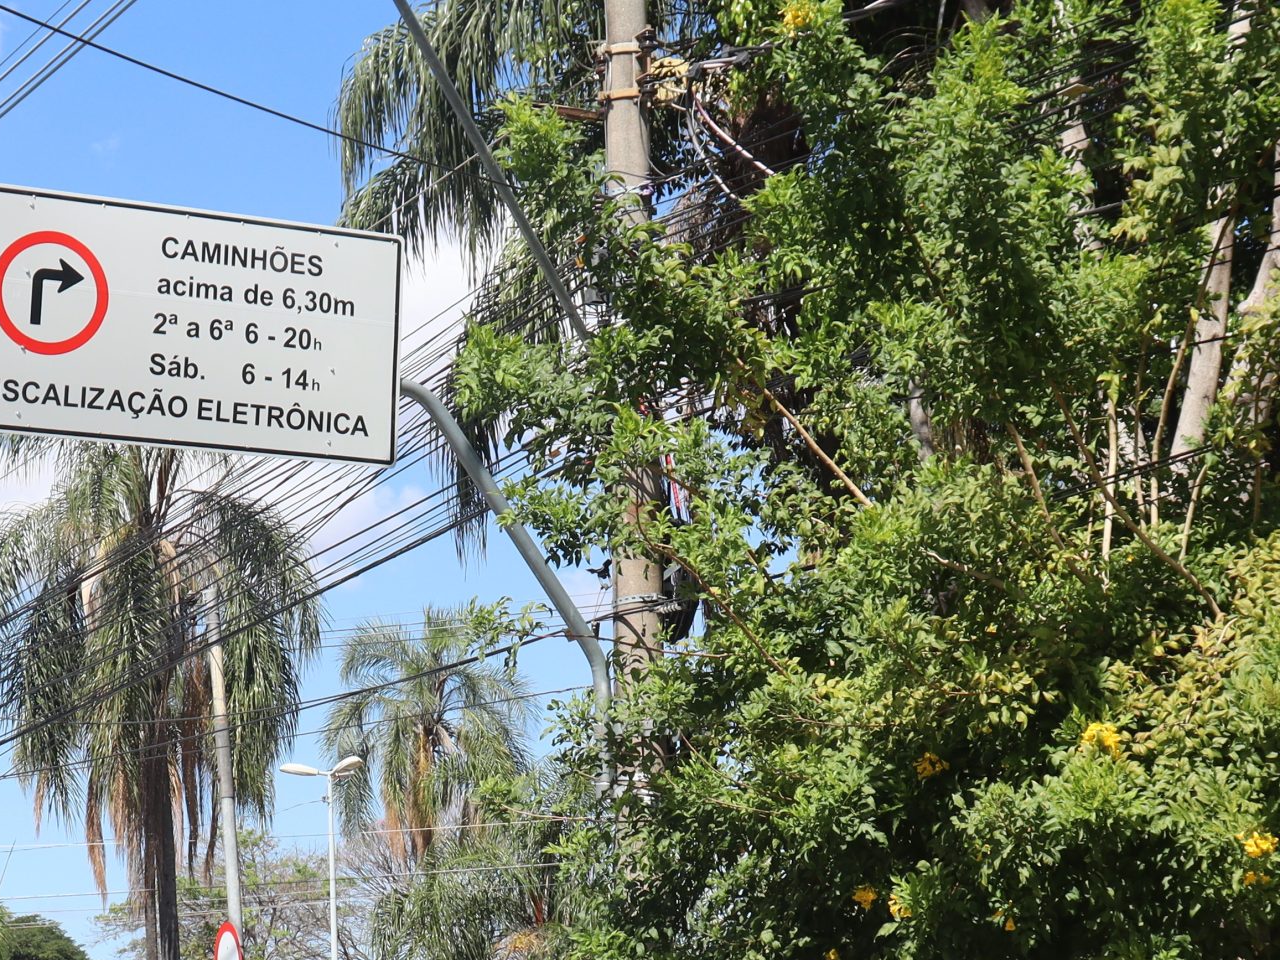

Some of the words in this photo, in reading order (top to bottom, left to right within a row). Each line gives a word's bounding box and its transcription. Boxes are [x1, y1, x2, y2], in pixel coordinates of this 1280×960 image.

[161, 236, 323, 278] CAMINHÕES
[157, 277, 233, 302] acima
[243, 283, 274, 308] de
[282, 289, 356, 317] 6,30m
[153, 312, 179, 335] 2ª
[186, 323, 201, 339] a
[209, 317, 234, 341] 6ª
[245, 323, 259, 345] 6
[283, 327, 322, 351] 20h
[149, 353, 206, 381] Sáb.
[241, 363, 255, 386] 6
[281, 368, 320, 392] 14h
[197, 402, 369, 437] ELETRÔNICA
